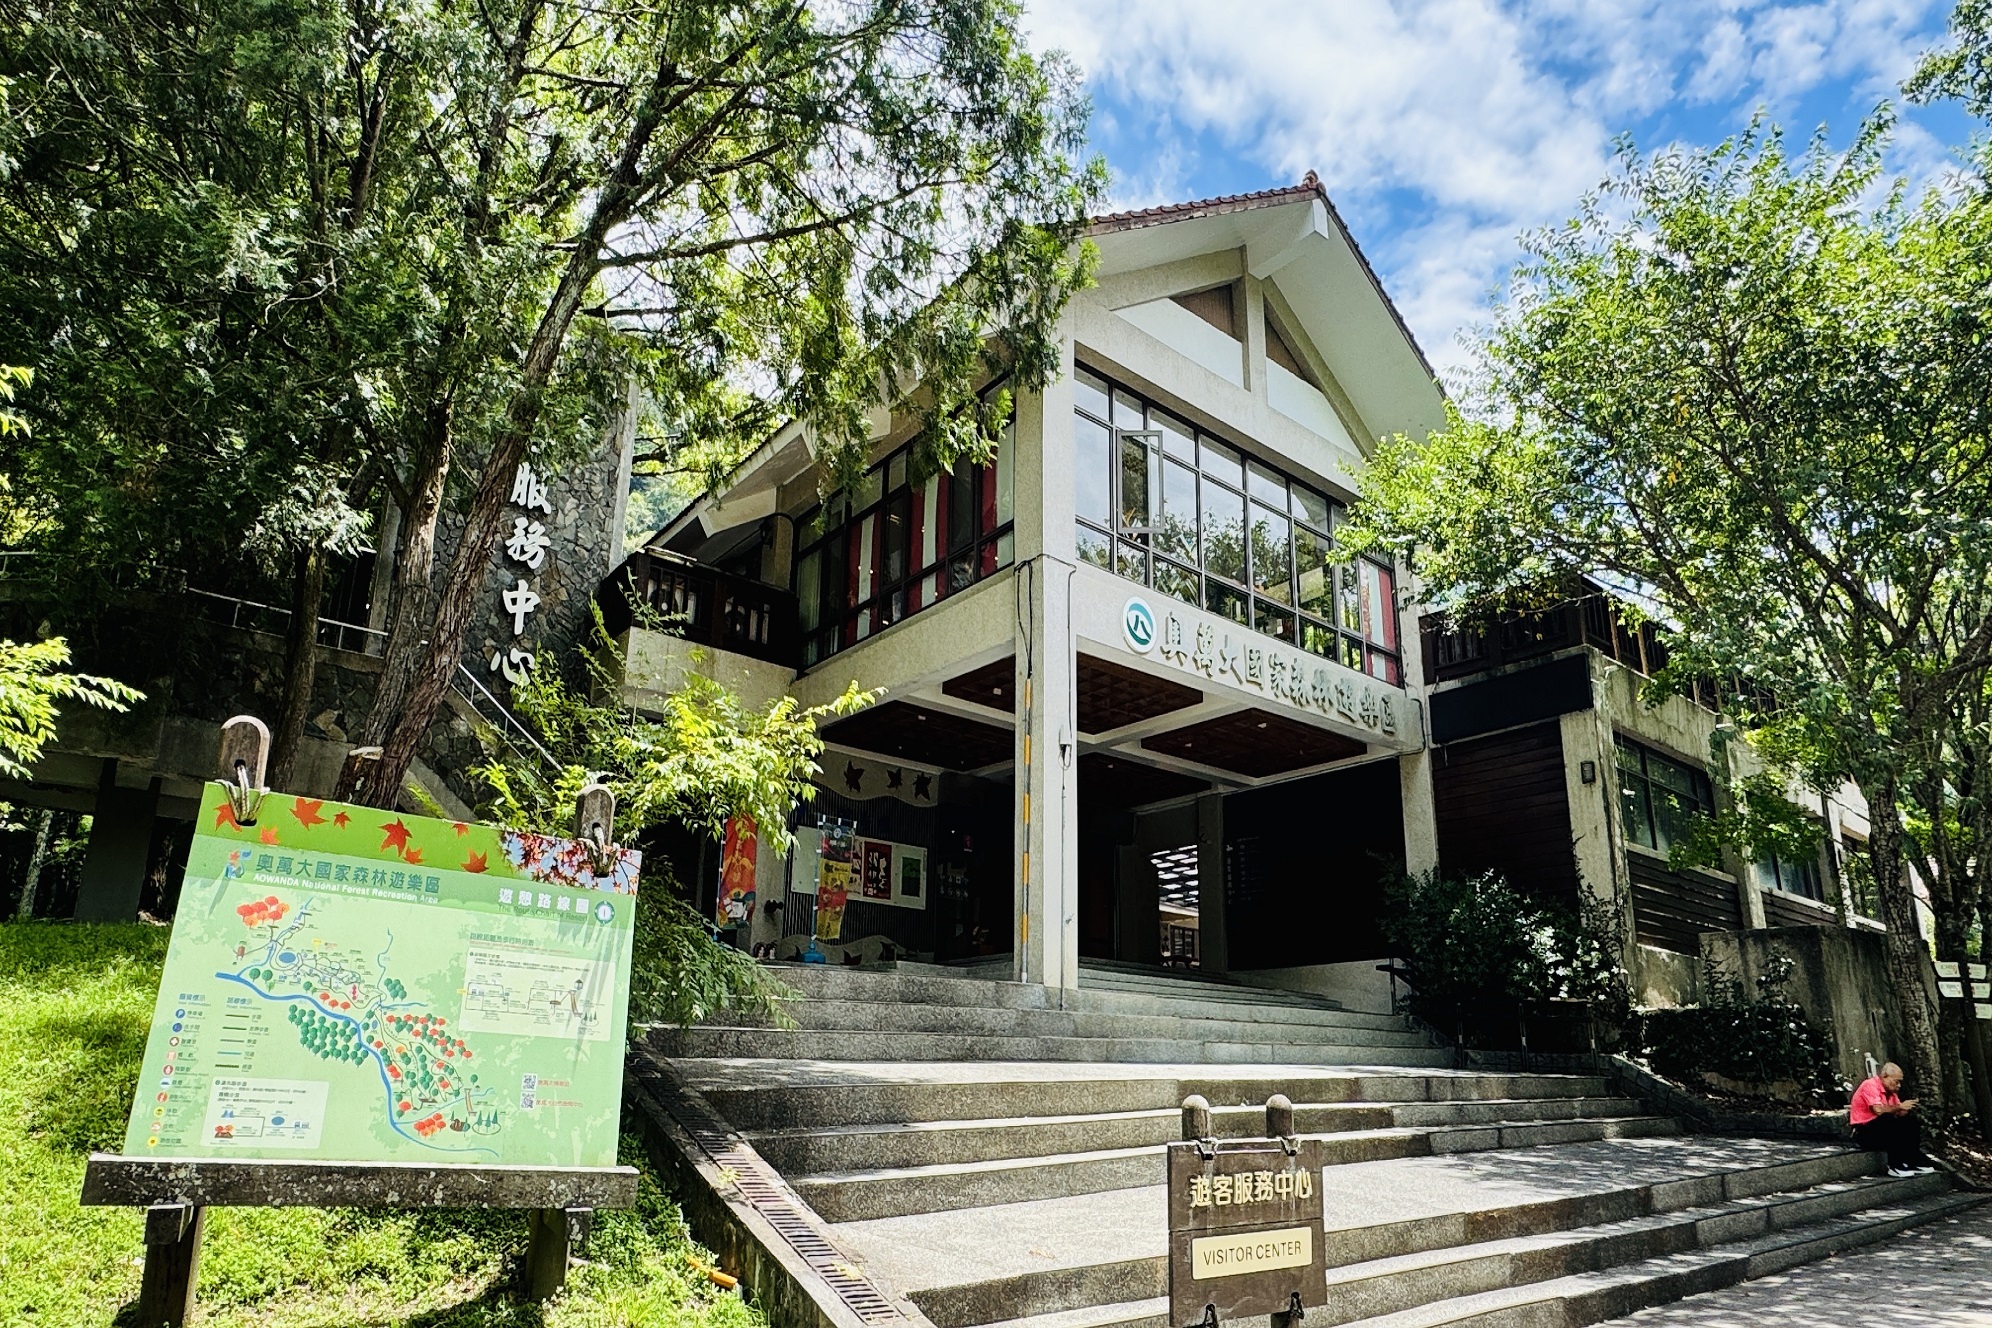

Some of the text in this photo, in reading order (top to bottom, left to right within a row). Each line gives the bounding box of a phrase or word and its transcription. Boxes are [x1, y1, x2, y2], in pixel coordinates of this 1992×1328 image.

[490, 461, 552, 687] 服務中心
[253, 873, 300, 886] AOWANDA
[302, 879, 340, 892] National
[342, 884, 370, 896] Forest
[372, 889, 418, 901] Recreation
[255, 853, 441, 894] 奧萬大國家森林遊樂區
[1189, 1167, 1313, 1208] 遊客服務中心
[1203, 1240, 1302, 1266] VISITOR CENTER
